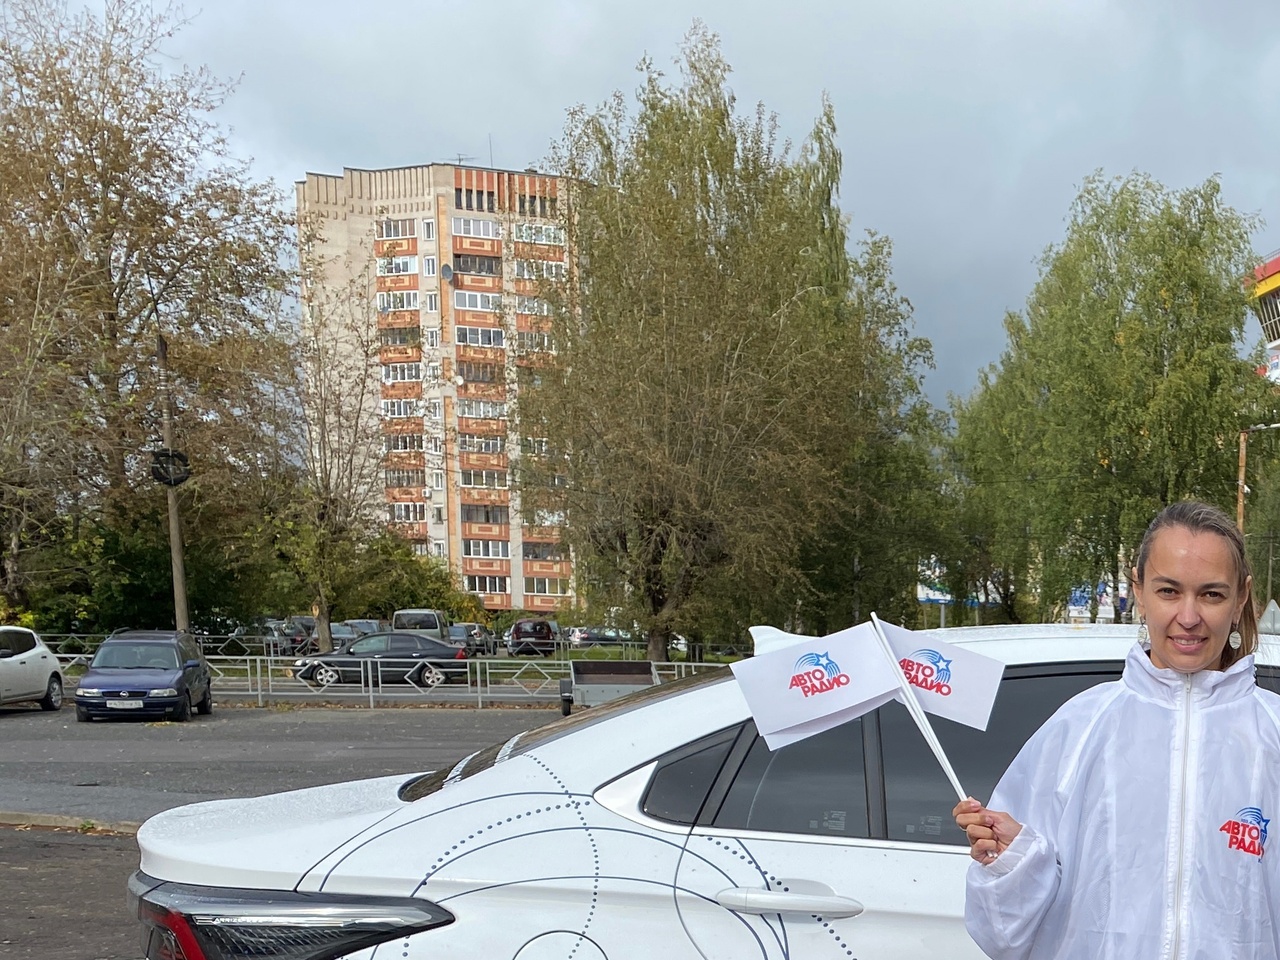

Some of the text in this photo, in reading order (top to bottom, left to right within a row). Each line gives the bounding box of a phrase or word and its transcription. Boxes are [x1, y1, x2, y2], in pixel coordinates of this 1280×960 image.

[788, 669, 825, 689] АВТО
[800, 674, 850, 698] РАДИО
[1219, 819, 1260, 841] АВТО
[1228, 835, 1264, 860] РАД
